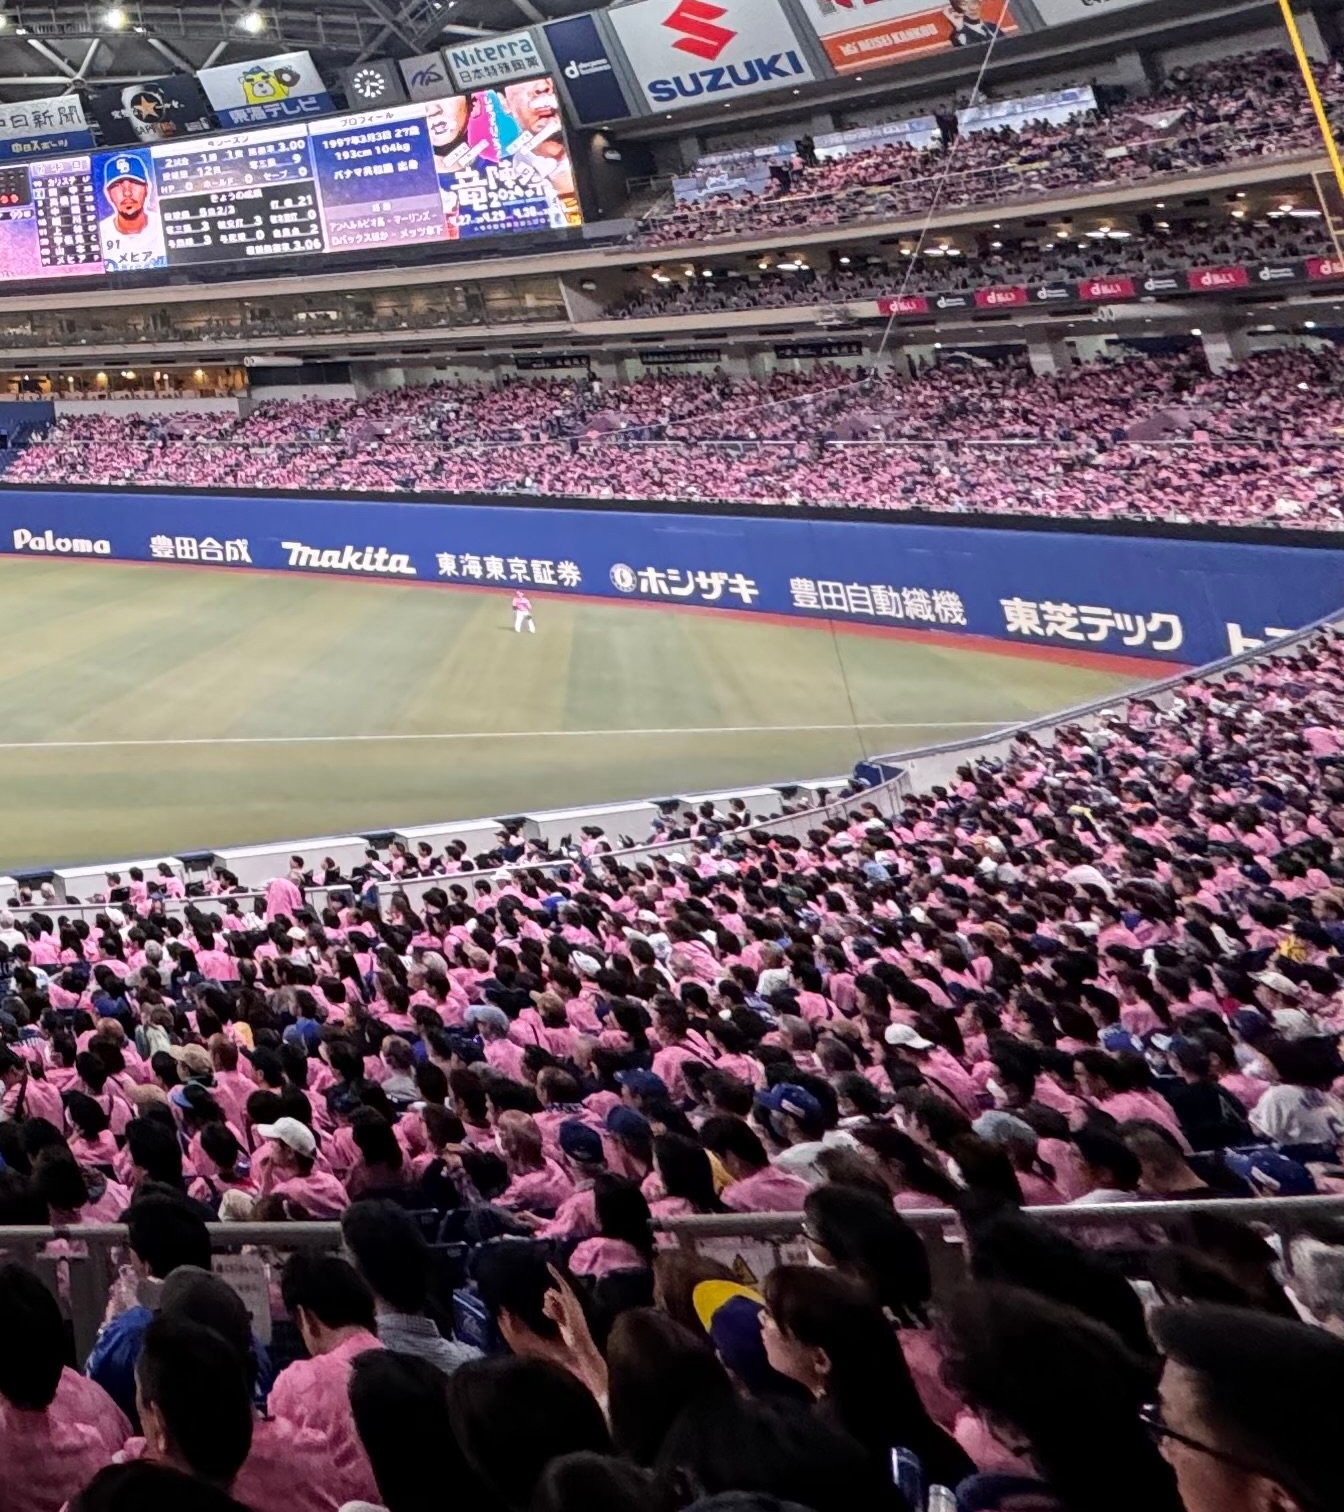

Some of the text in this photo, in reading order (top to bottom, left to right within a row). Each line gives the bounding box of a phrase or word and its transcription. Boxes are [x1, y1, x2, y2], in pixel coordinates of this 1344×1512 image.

[453, 37, 533, 69] Niterra
[458, 56, 540, 83] 日本特殊陶業
[646, 49, 805, 103] SUZUKI
[228, 96, 321, 125] 東海テレビ
[340, 110, 395, 127] プロフィール
[278, 139, 306, 153] 3.00
[334, 147, 373, 161] 193cm
[298, 194, 313, 206] 21
[106, 239, 121, 250] 91
[118, 250, 153, 264] メヒア
[293, 237, 322, 254] 3.06
[12, 528, 111, 555] Paloma
[149, 534, 253, 564] 豊田合成
[434, 551, 582, 588] 東海東京証券
[637, 565, 760, 604] ホシザキ
[789, 575, 968, 627] 豊田自動織機
[998, 596, 1184, 652] 東芝テック
[1224, 621, 1296, 657] ト
